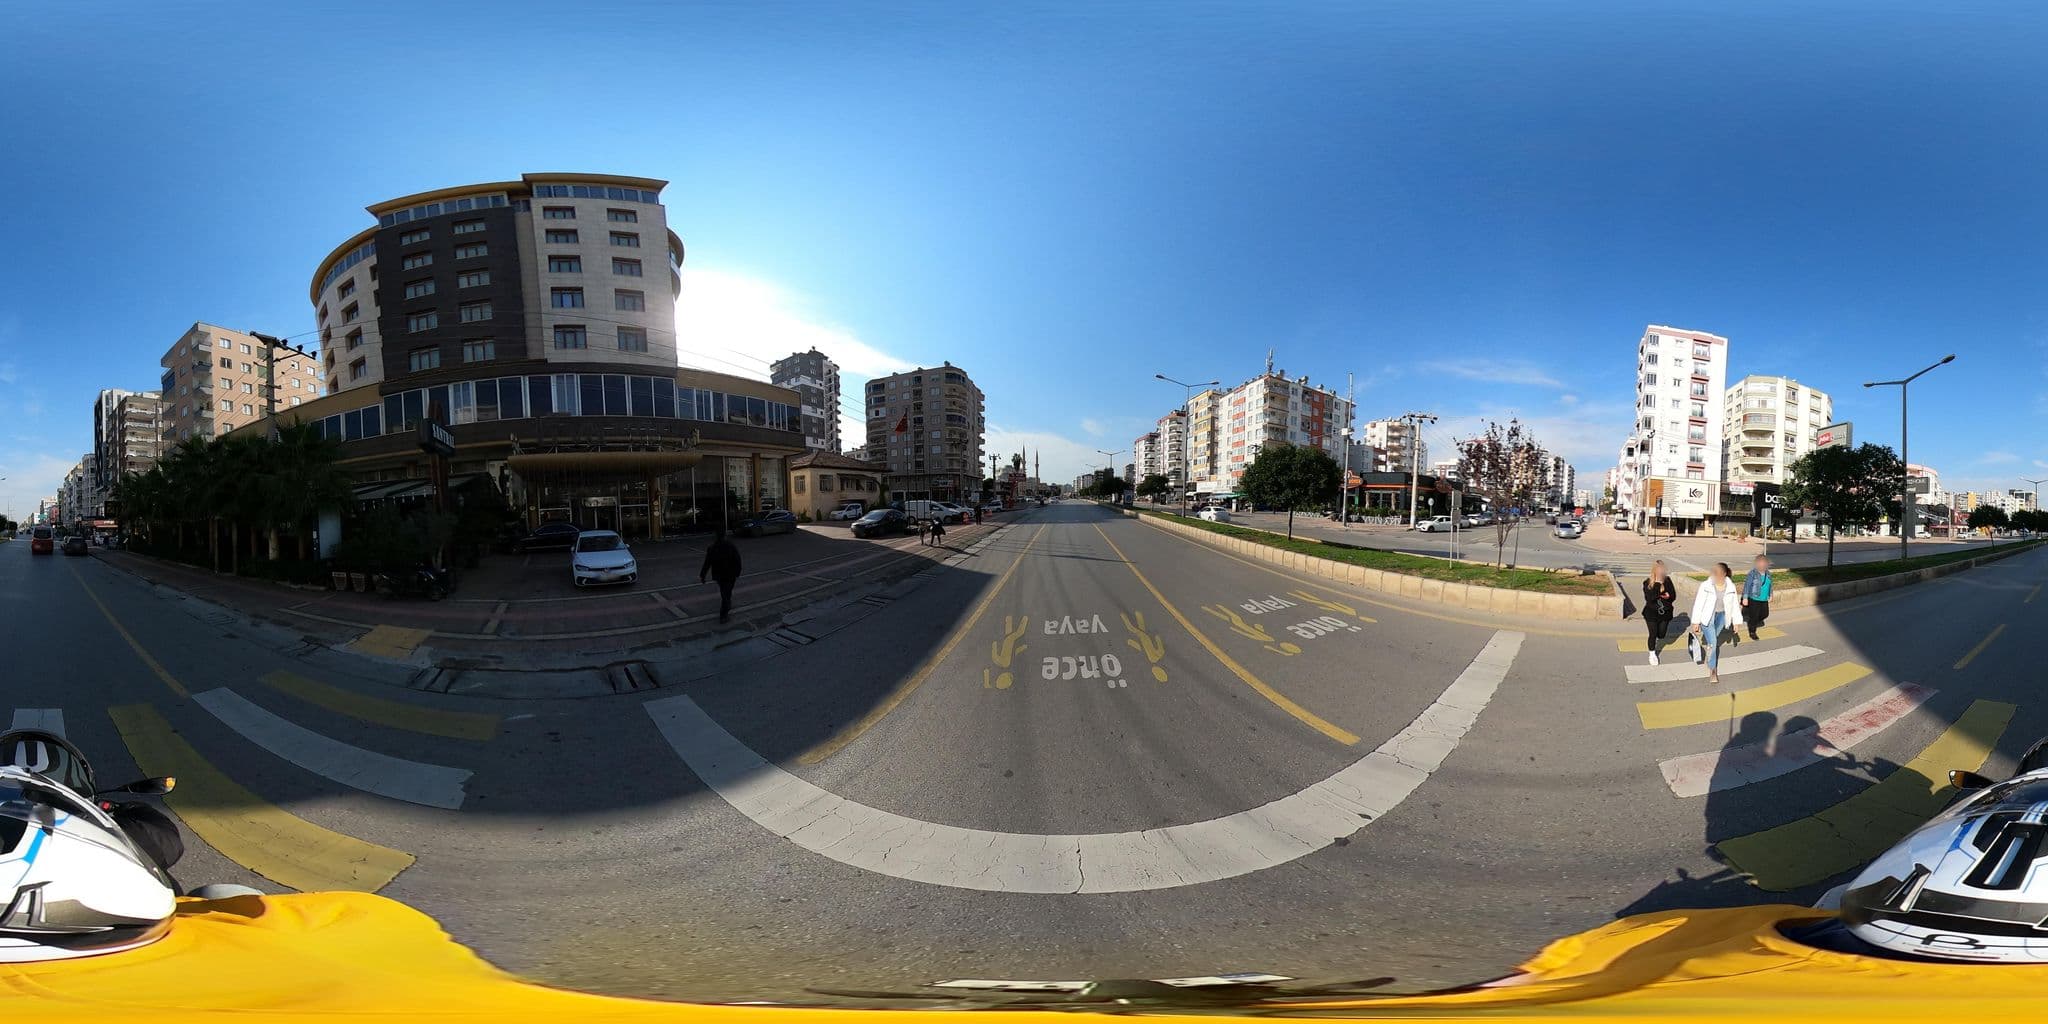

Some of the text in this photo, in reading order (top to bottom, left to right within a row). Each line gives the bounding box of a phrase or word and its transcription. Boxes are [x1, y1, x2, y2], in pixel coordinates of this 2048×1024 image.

[1240, 595, 1297, 615] yaya
[1044, 614, 1109, 635] yaya
[1286, 616, 1362, 639] önce
[1042, 654, 1128, 689] önce
